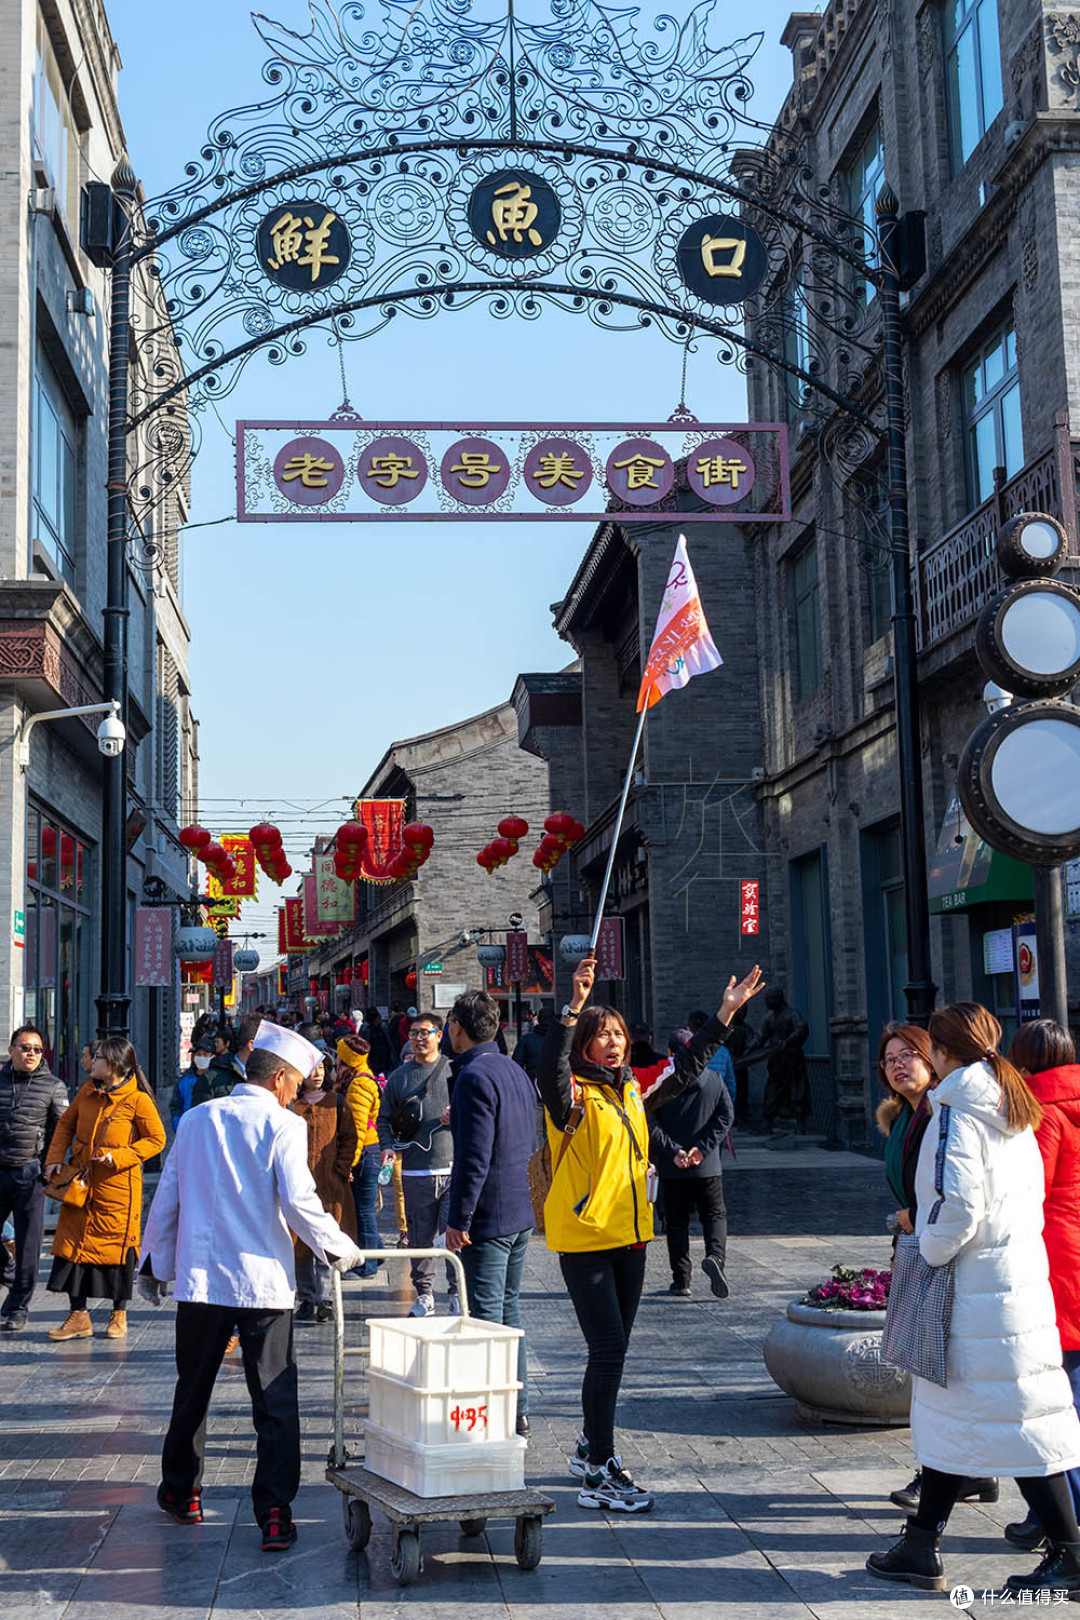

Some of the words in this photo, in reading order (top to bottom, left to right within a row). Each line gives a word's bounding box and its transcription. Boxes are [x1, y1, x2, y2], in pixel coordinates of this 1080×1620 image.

[282, 452, 747, 490] 老字号美食街
[942, 895, 952, 908] TEA
[954, 892, 966, 904] BAR
